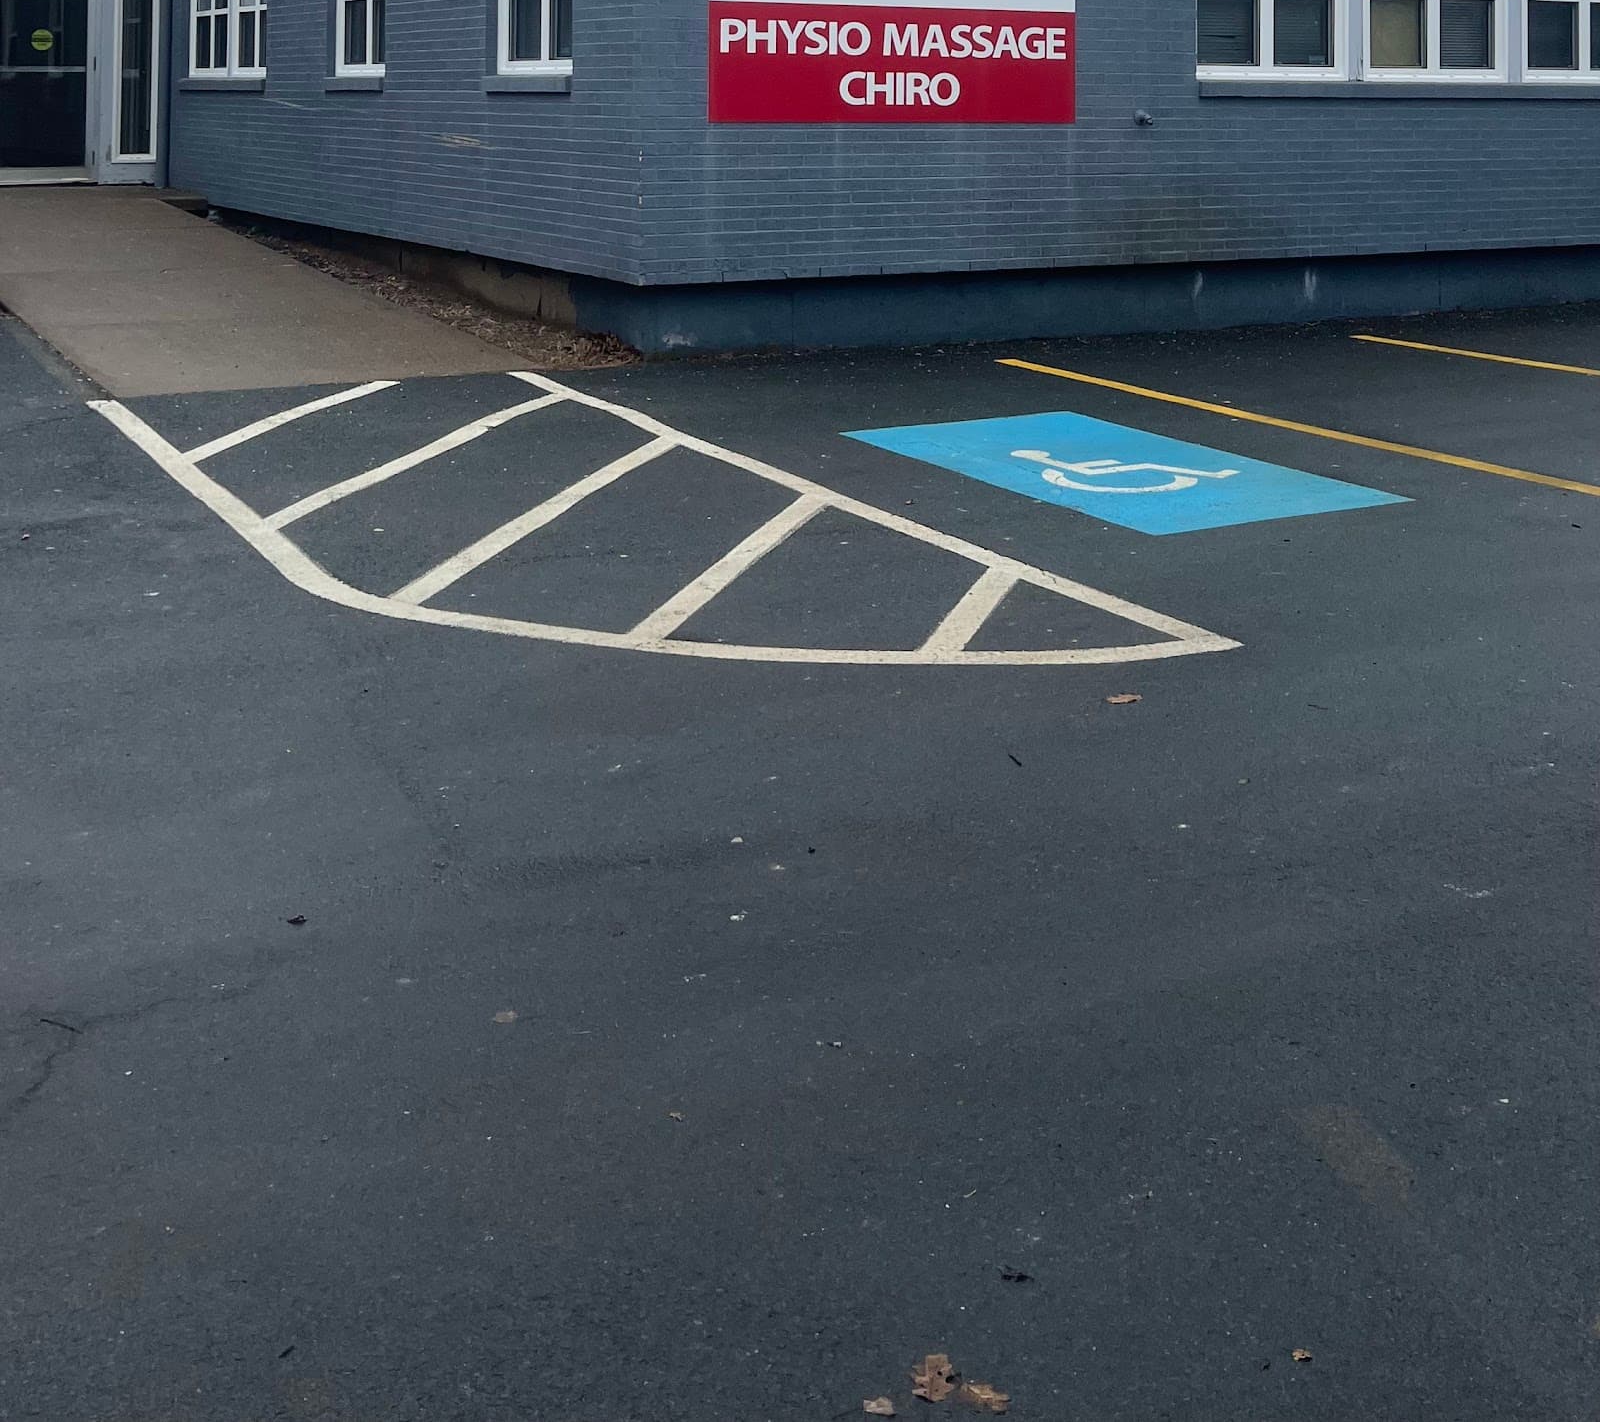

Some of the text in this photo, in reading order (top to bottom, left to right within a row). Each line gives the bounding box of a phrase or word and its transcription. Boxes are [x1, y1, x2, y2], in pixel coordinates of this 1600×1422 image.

[720, 18, 1066, 60] PHYSIO MASSAGE
[839, 71, 960, 106] CHIRO
